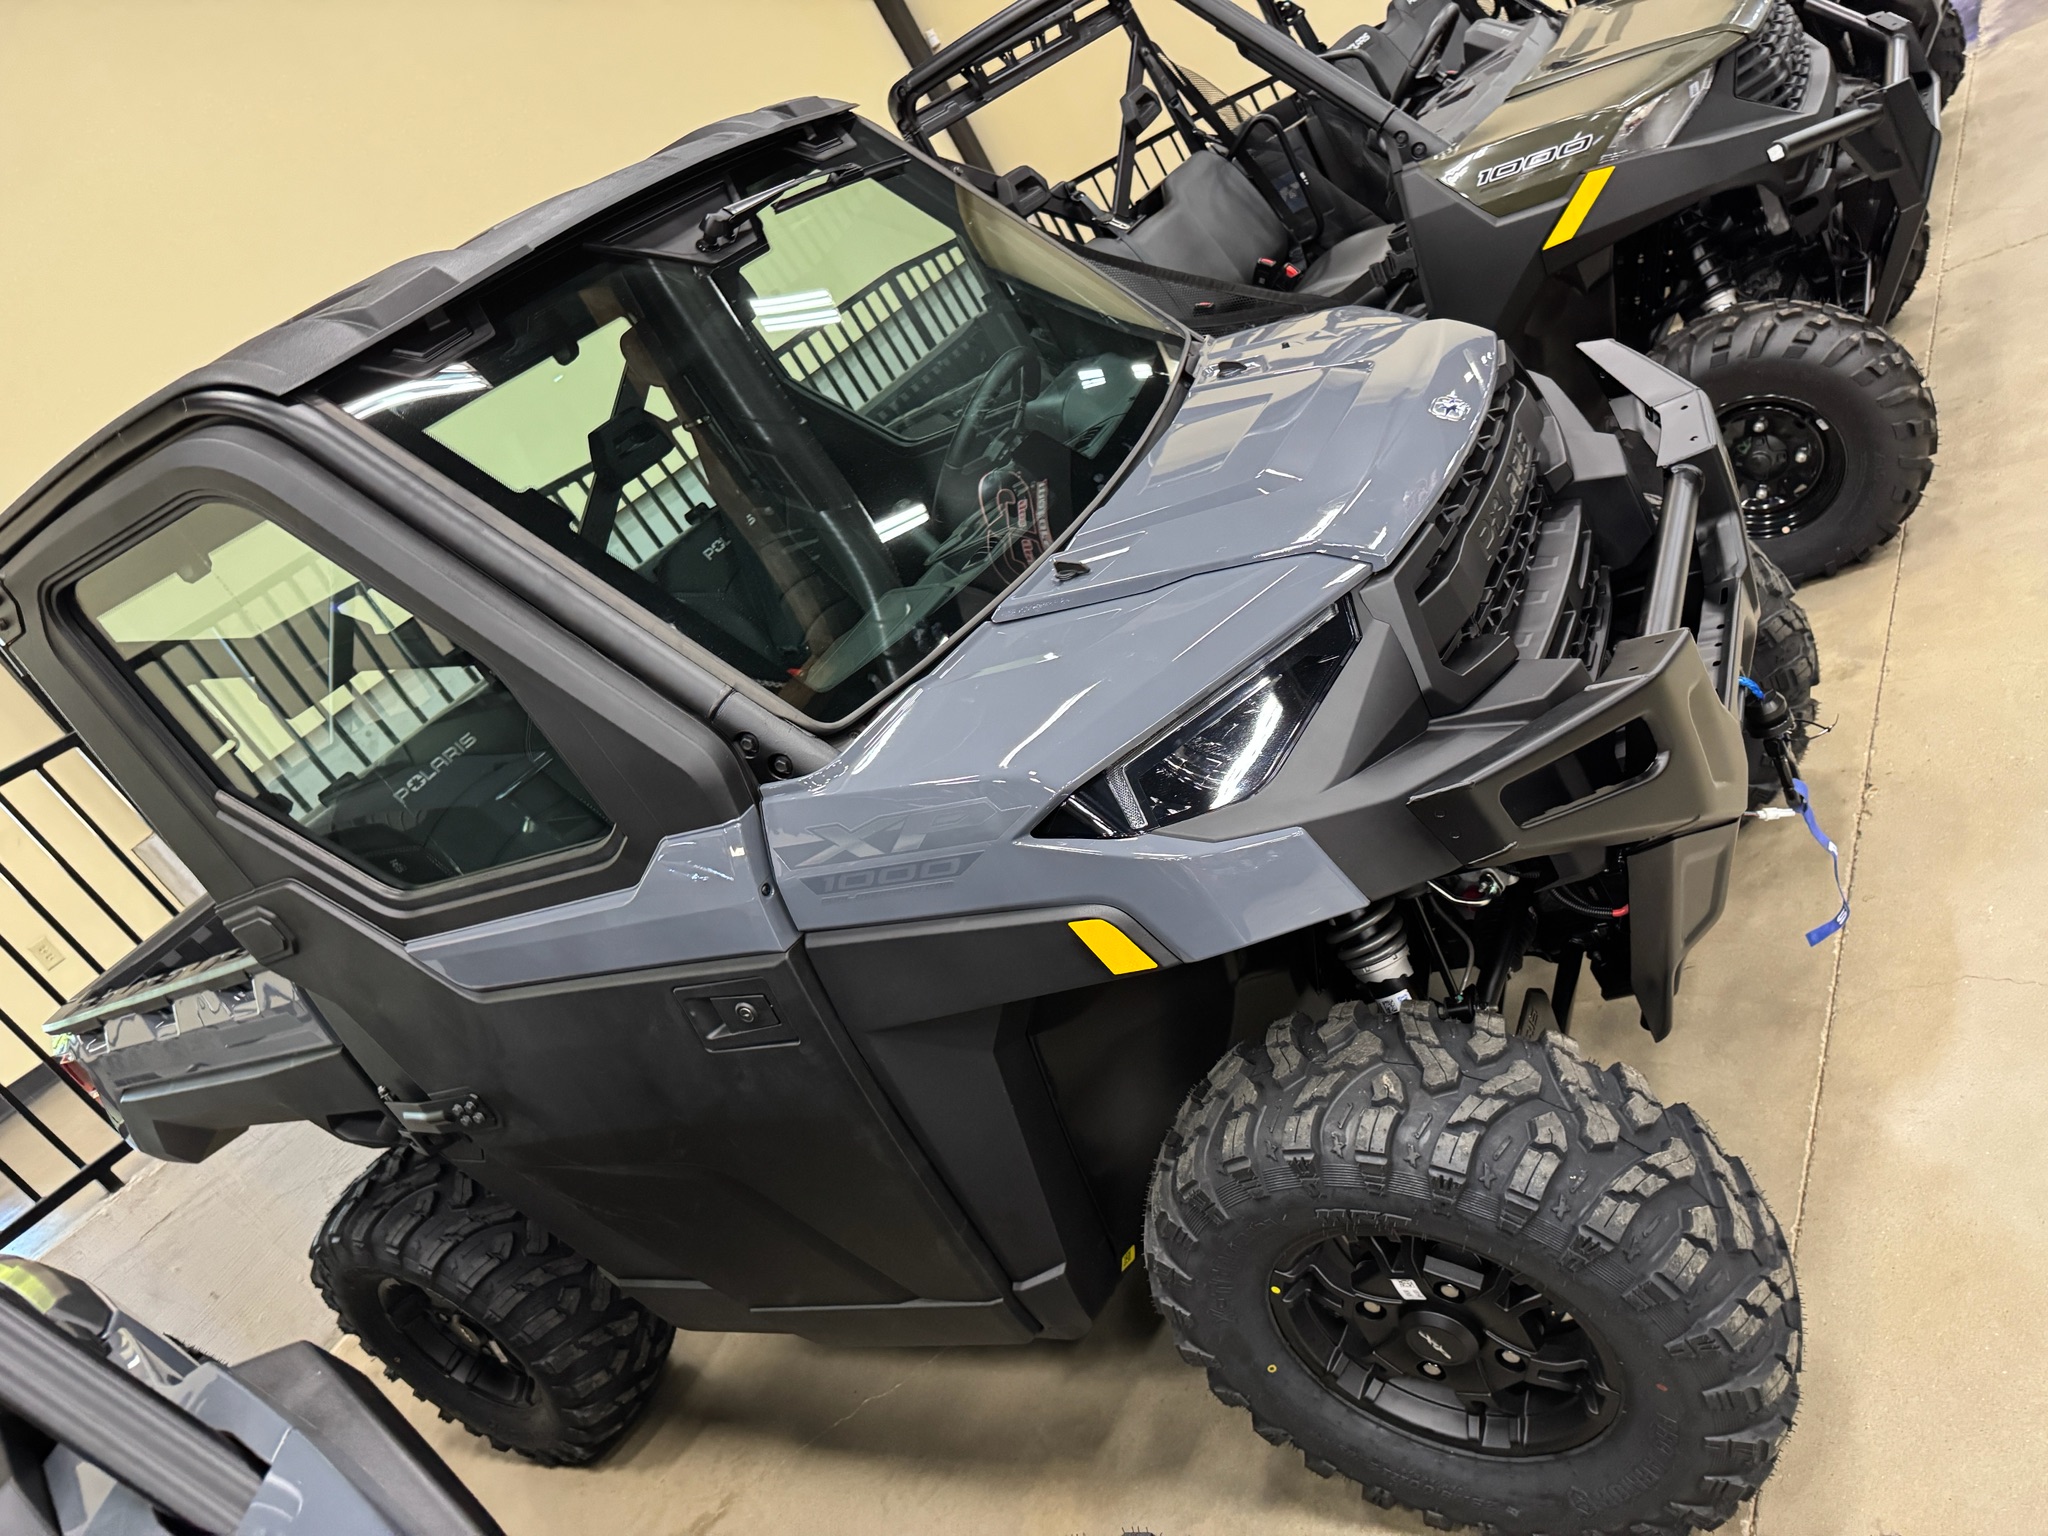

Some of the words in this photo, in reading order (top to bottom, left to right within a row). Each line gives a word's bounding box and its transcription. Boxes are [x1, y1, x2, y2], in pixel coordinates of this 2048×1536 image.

[1476, 134, 1594, 187] 1000
[393, 731, 477, 802] POLARIS
[795, 799, 998, 869] XP
[821, 857, 961, 893] 1000
